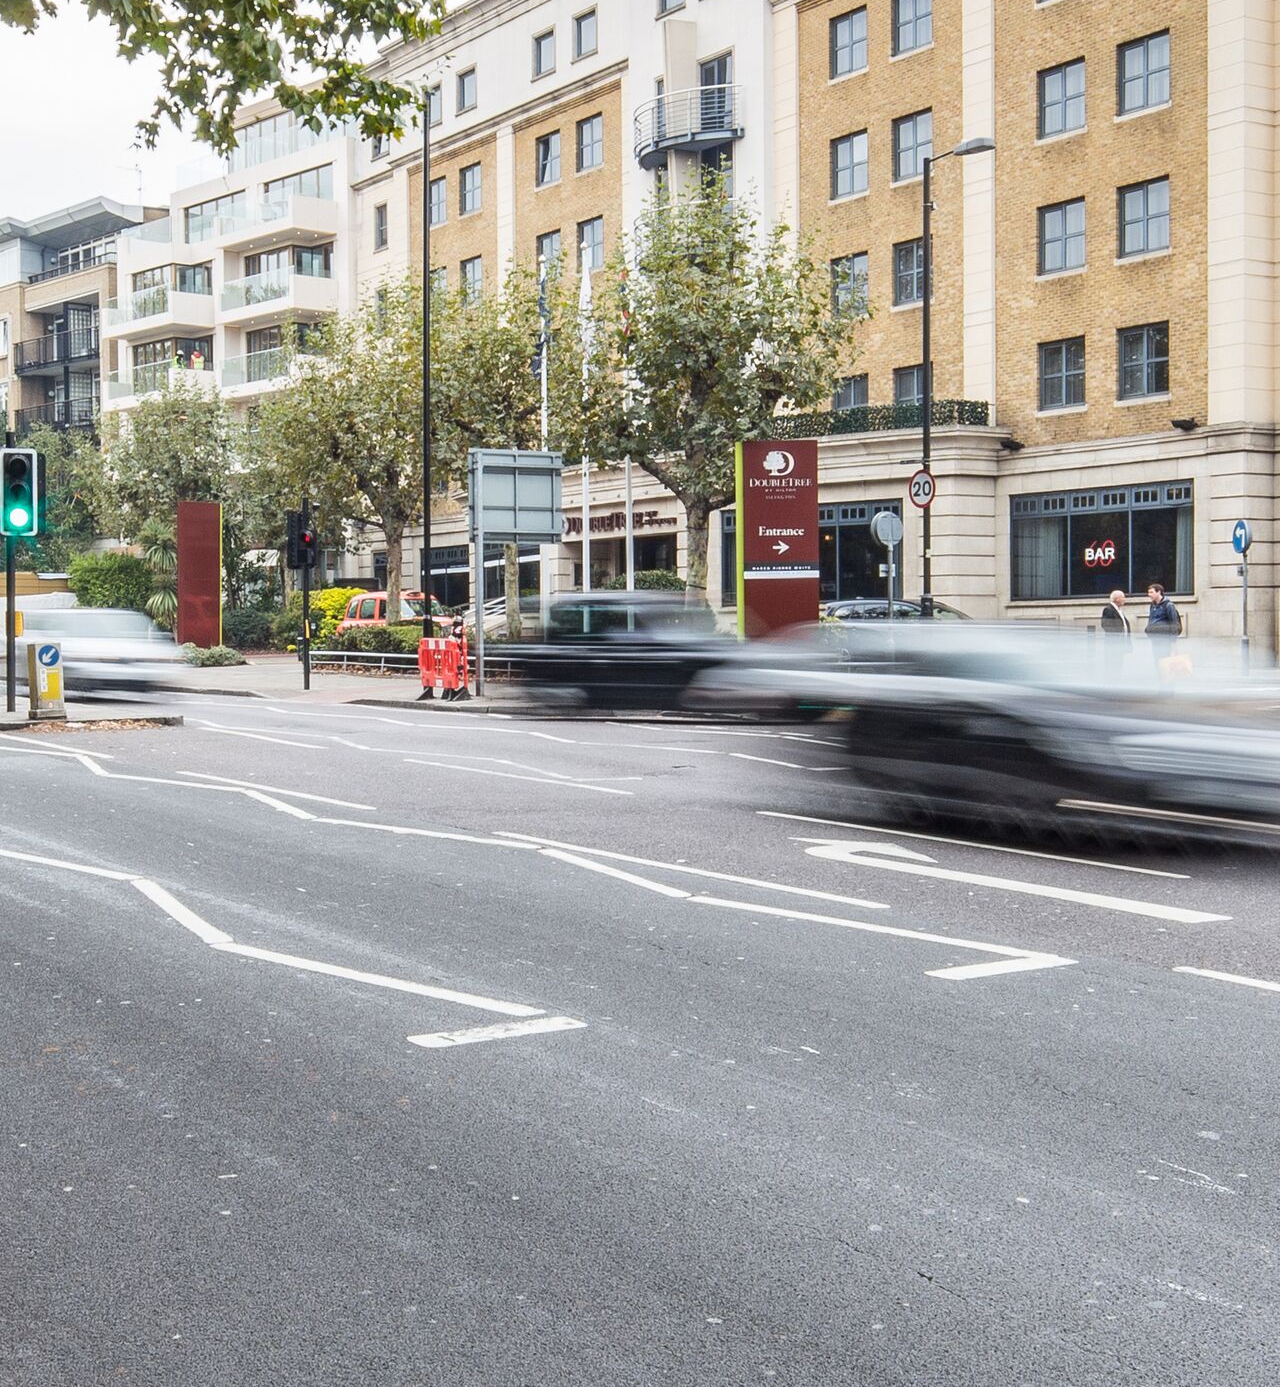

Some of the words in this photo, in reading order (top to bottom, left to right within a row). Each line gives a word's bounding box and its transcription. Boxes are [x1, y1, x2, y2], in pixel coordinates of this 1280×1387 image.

[749, 478, 813, 488] DOUBLETREE
[913, 481, 931, 497] 20
[758, 526, 805, 536] Entrance
[1085, 548, 1115, 561] BAR
